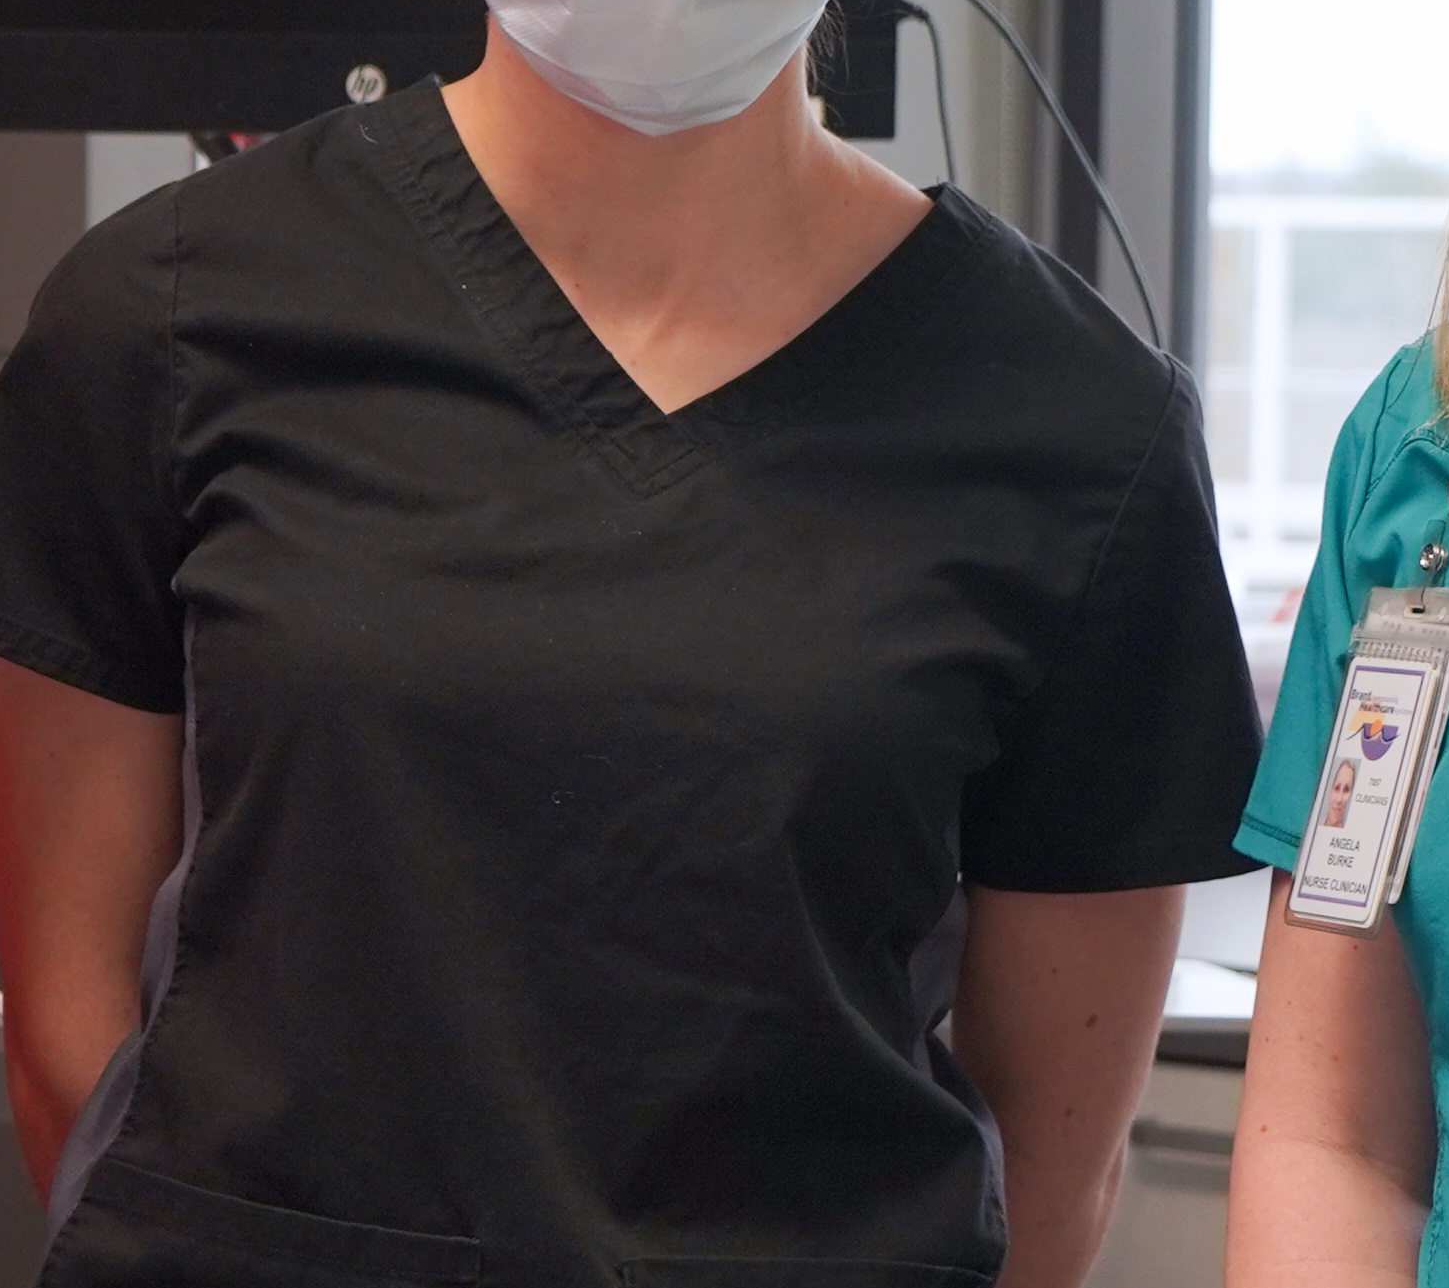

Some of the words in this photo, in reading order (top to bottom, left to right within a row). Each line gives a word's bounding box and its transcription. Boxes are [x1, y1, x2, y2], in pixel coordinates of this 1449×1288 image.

[353, 66, 378, 102] hp
[1329, 836, 1361, 851] ANGELA
[1327, 853, 1355, 868] BURKE
[1303, 875, 1329, 890] NURSE
[1330, 879, 1368, 895] CLINICIAN
